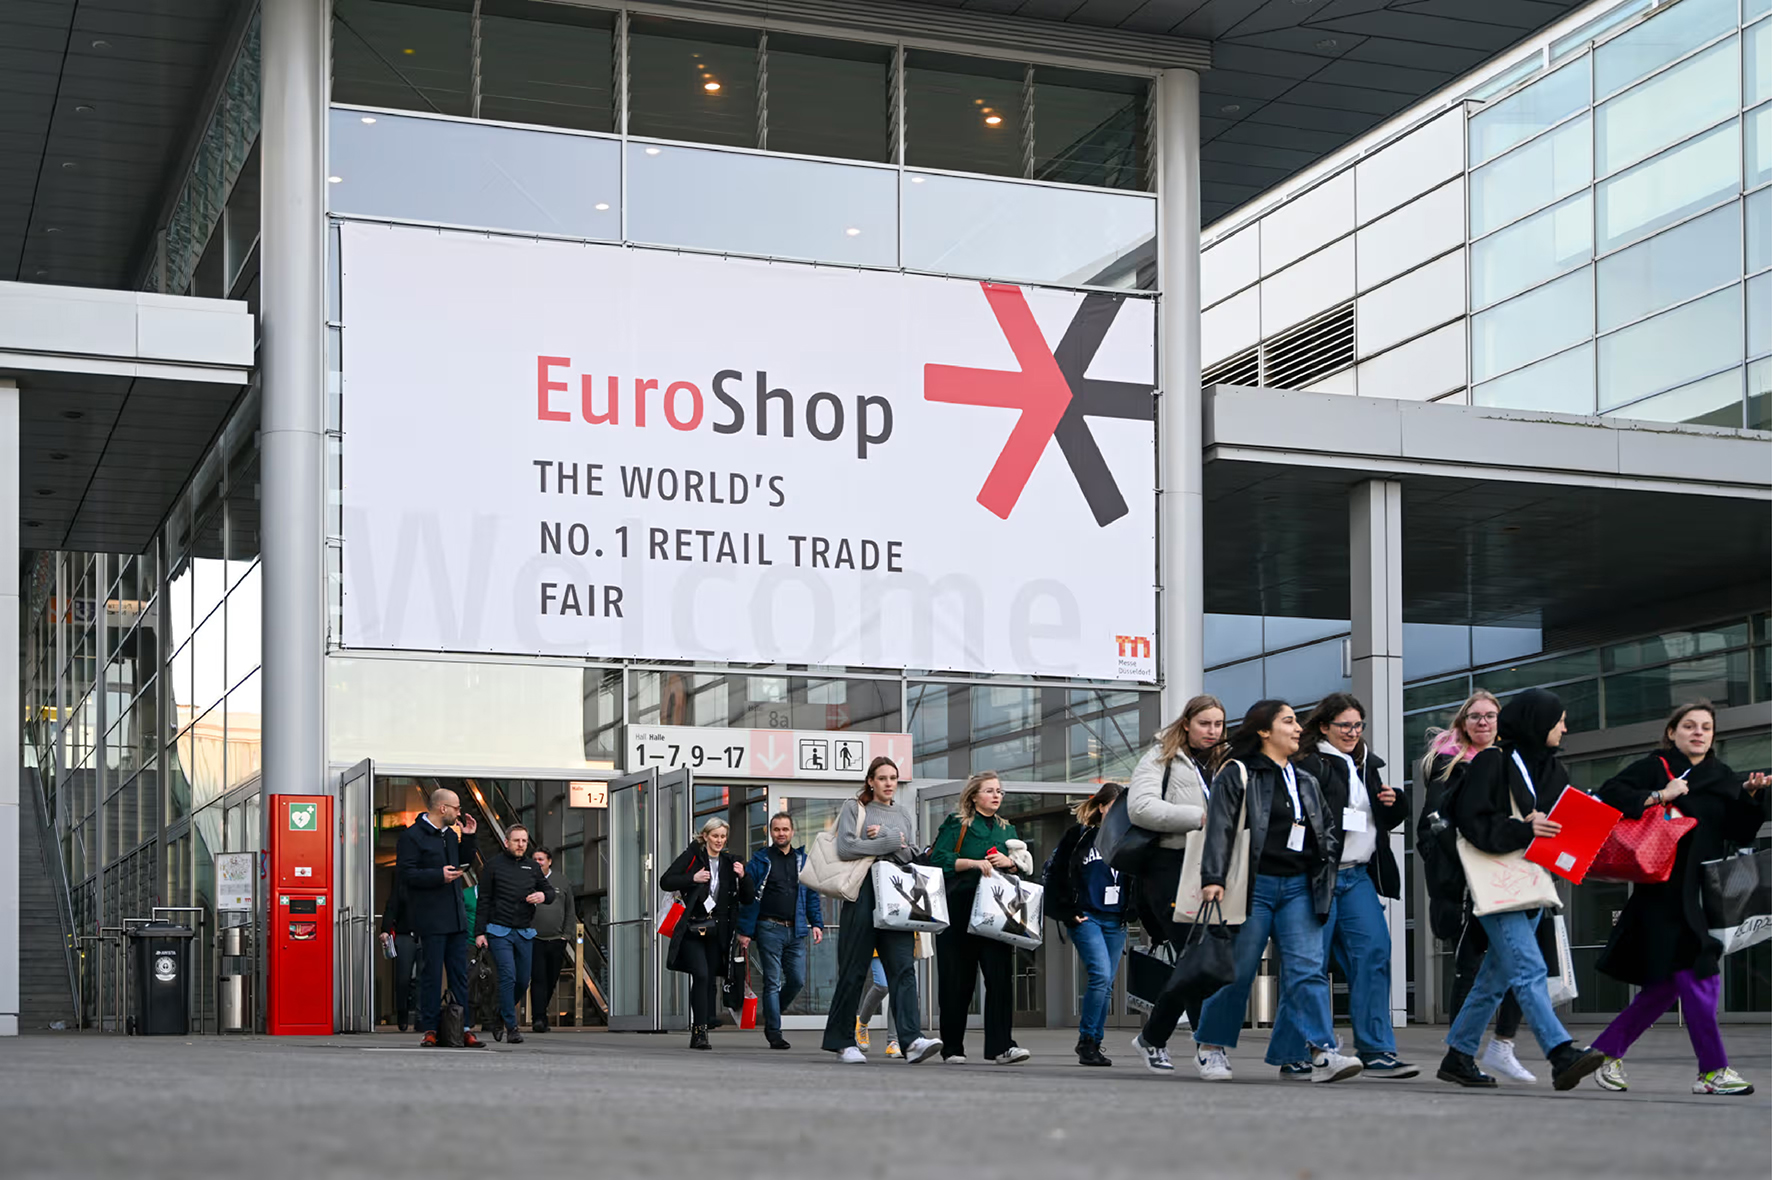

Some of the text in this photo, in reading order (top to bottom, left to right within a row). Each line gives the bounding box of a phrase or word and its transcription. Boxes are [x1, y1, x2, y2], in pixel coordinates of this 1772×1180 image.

[537, 355, 894, 460] EuroShop
[533, 460, 785, 508] THE WORLD'S
[649, 527, 773, 566] RETAIL
[787, 535, 903, 573] TRADE
[342, 506, 1082, 672] Welcome
[540, 582, 624, 618] FAIR
[1118, 667, 1151, 676] Düsseldorf
[769, 710, 789, 729] 8a
